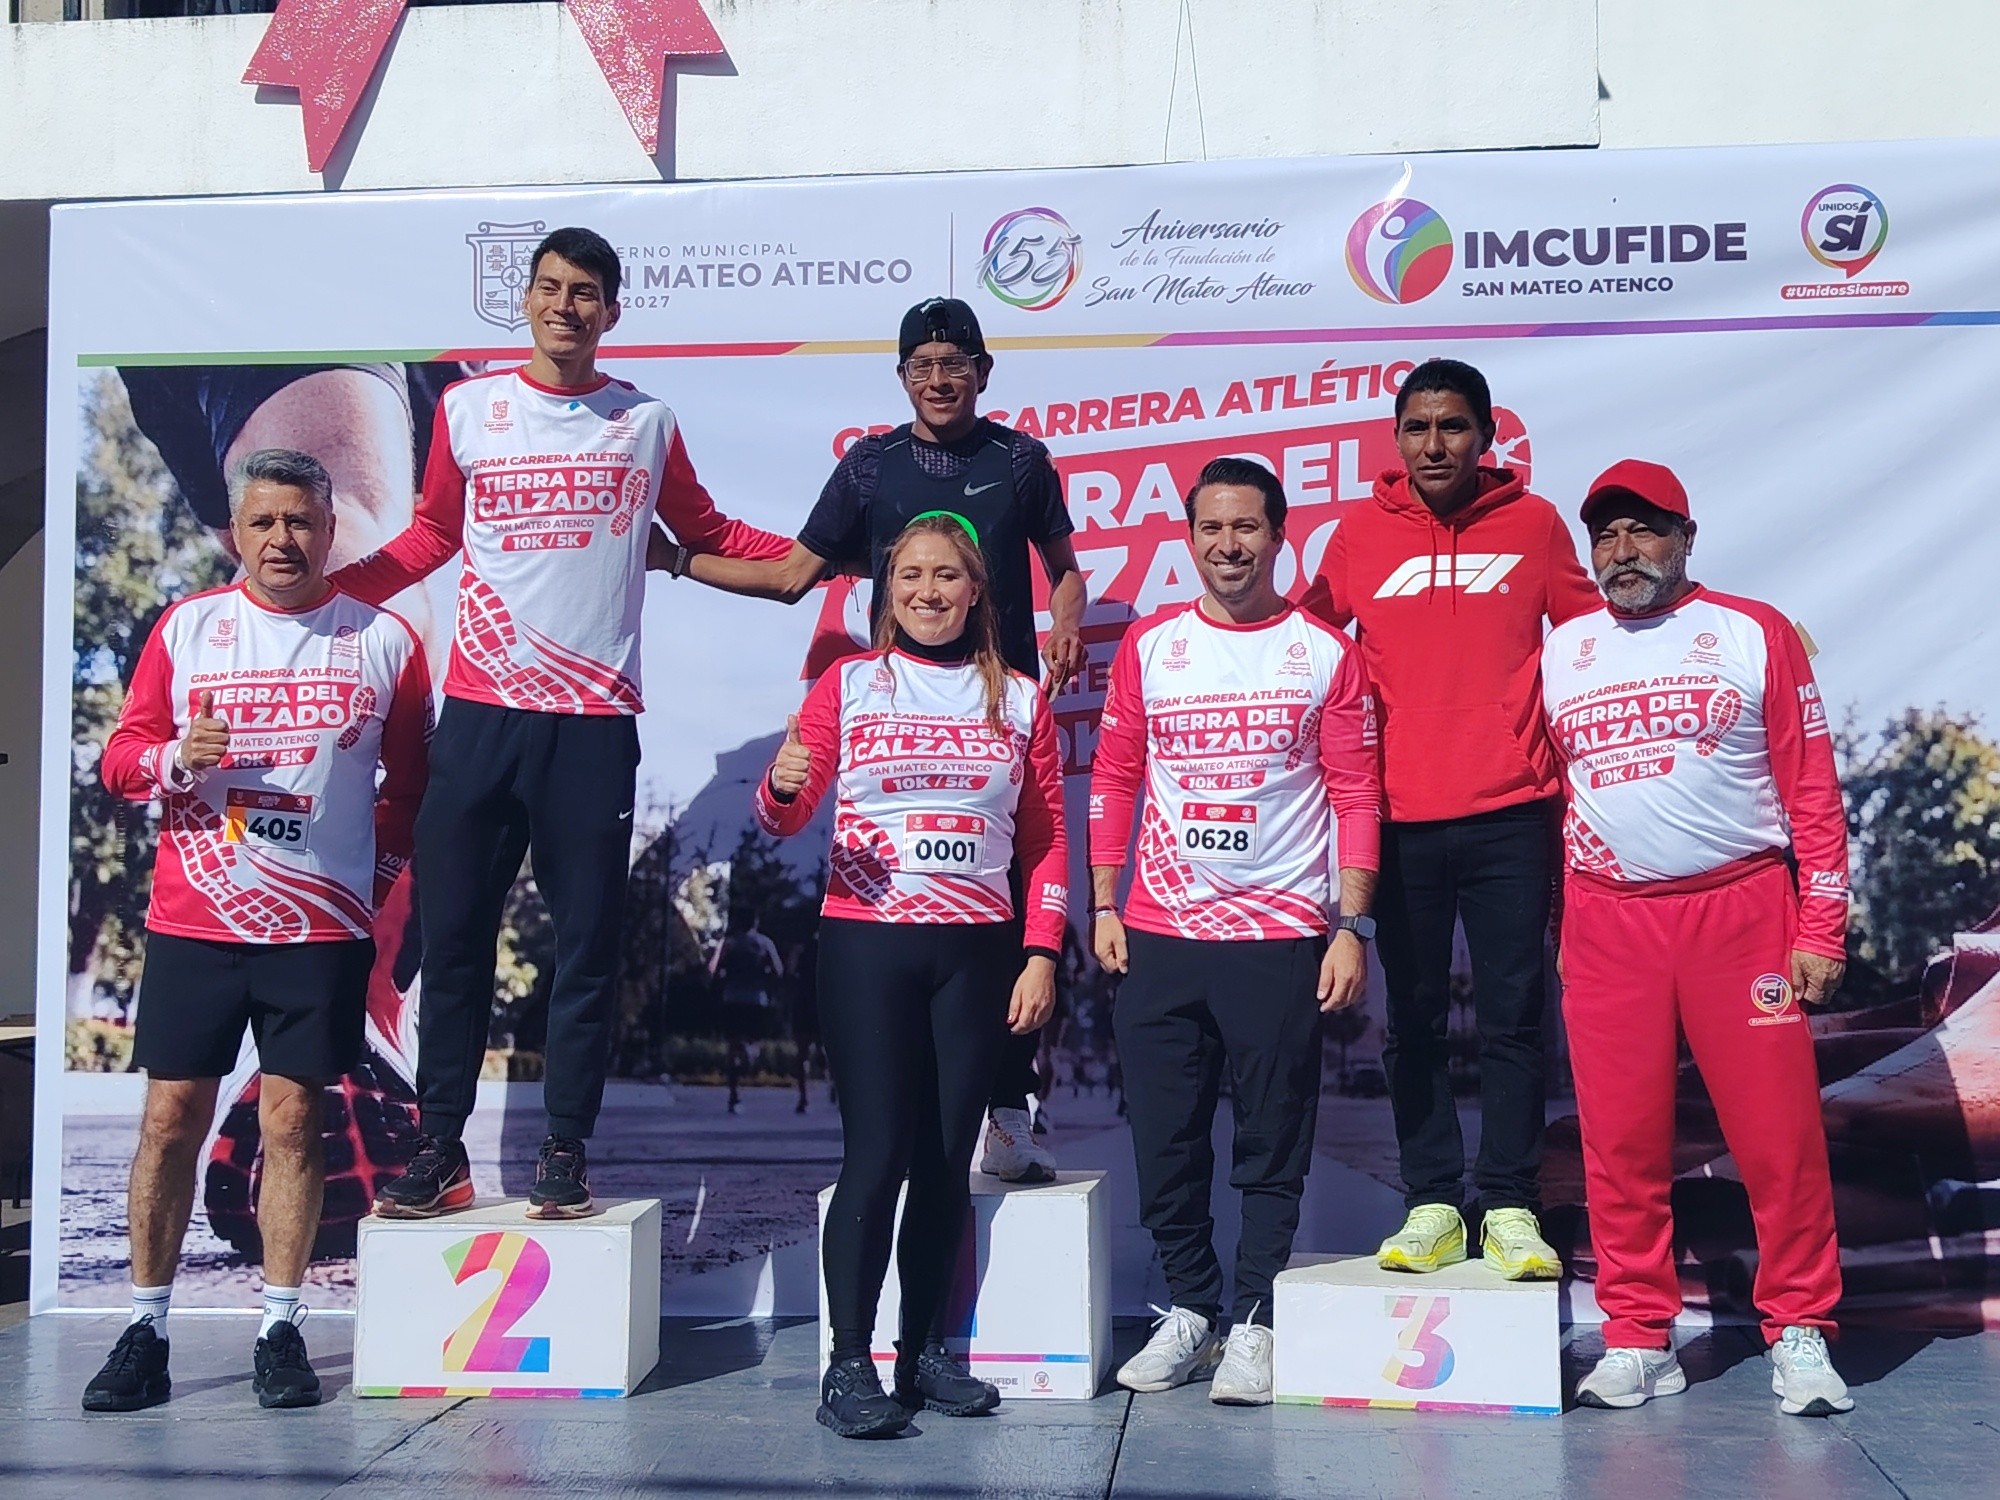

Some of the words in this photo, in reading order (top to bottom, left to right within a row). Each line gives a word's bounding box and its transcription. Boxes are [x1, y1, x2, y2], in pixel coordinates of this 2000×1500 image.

[1818, 203, 1859, 212] UNIDOS
[1110, 209, 1284, 248] Aniversario
[1820, 200, 1873, 252] SÍ
[682, 243, 798, 258] MUNICIPAL
[1119, 252, 1140, 267] de
[1142, 249, 1159, 266] la
[1164, 246, 1252, 268] Fundación
[1255, 246, 1276, 263] de
[1464, 222, 1748, 269] IMCUFIDE
[976, 234, 1082, 288] 155
[643, 262, 762, 289] MATEO
[771, 259, 912, 286] ATENCO
[1085, 276, 1137, 307] San
[1142, 274, 1229, 305] Mateo
[1226, 272, 1316, 304] Atenco
[1462, 281, 1504, 297] SAN
[1510, 279, 1583, 295] MATEO
[1588, 276, 1674, 293] ATENCO
[1785, 283, 1908, 299] #UnidosSiempre
[1215, 356, 1441, 417] ATLÉTIC
[472, 457, 507, 470] GRAN
[510, 454, 573, 466] CARRERA
[575, 450, 634, 463] ATLÉTICA
[482, 471, 567, 493] TIERRA
[574, 470, 617, 487] DEL
[478, 490, 617, 518] CALZADO
[492, 523, 512, 533] SAN
[514, 520, 551, 531] MATEO
[553, 519, 595, 528] ATENCO
[512, 534, 546, 550] 10K
[556, 534, 581, 548] 5K
[190, 671, 229, 683] GRAN
[231, 668, 296, 680] CARRERA
[298, 665, 361, 679] ATLÉTICA
[297, 684, 344, 703] DEL
[1153, 696, 1182, 710] GRAN
[1184, 692, 1247, 705] CARRERA
[1249, 687, 1313, 700] ATLÉTICA
[1558, 692, 1586, 711] GRAN
[1588, 680, 1648, 700] CARRERA
[1650, 673, 1720, 688] ATLÉTICA
[194, 703, 345, 730] ALZADO
[853, 712, 889, 724] GRAN
[892, 712, 955, 722] CARRERA
[1158, 711, 1241, 734] TIERRA
[1247, 708, 1295, 726] DEL
[1562, 699, 1643, 733] TIERRA
[1648, 693, 1700, 713] DEL
[234, 737, 273, 748] MATEO
[275, 733, 320, 746] ATENCO
[862, 723, 953, 739] TIERRA
[1159, 728, 1294, 756] CALZADO
[231, 752, 266, 768] 10K
[279, 749, 305, 765] 5K
[854, 738, 1011, 762] CALZADO
[1594, 751, 1630, 769] MATEO
[1632, 743, 1676, 759] ATENCO
[868, 765, 890, 777] SAN
[894, 763, 937, 774] MATEO
[941, 762, 993, 773] ATENCO
[1188, 761, 1224, 772] MATEO
[1226, 758, 1269, 770] ATENCO
[1598, 767, 1627, 786] 10K
[1638, 760, 1664, 777] 5K
[892, 776, 930, 791] 10K
[945, 776, 975, 788] 5K
[1188, 775, 1220, 789] 10K
[1230, 773, 1255, 787] 5K
[915, 838, 976, 864] 0001
[1186, 827, 1249, 852] 0628
[1810, 870, 1845, 886] 10K
[441, 1232, 551, 1372] 2
[1381, 1295, 1455, 1390] 3
